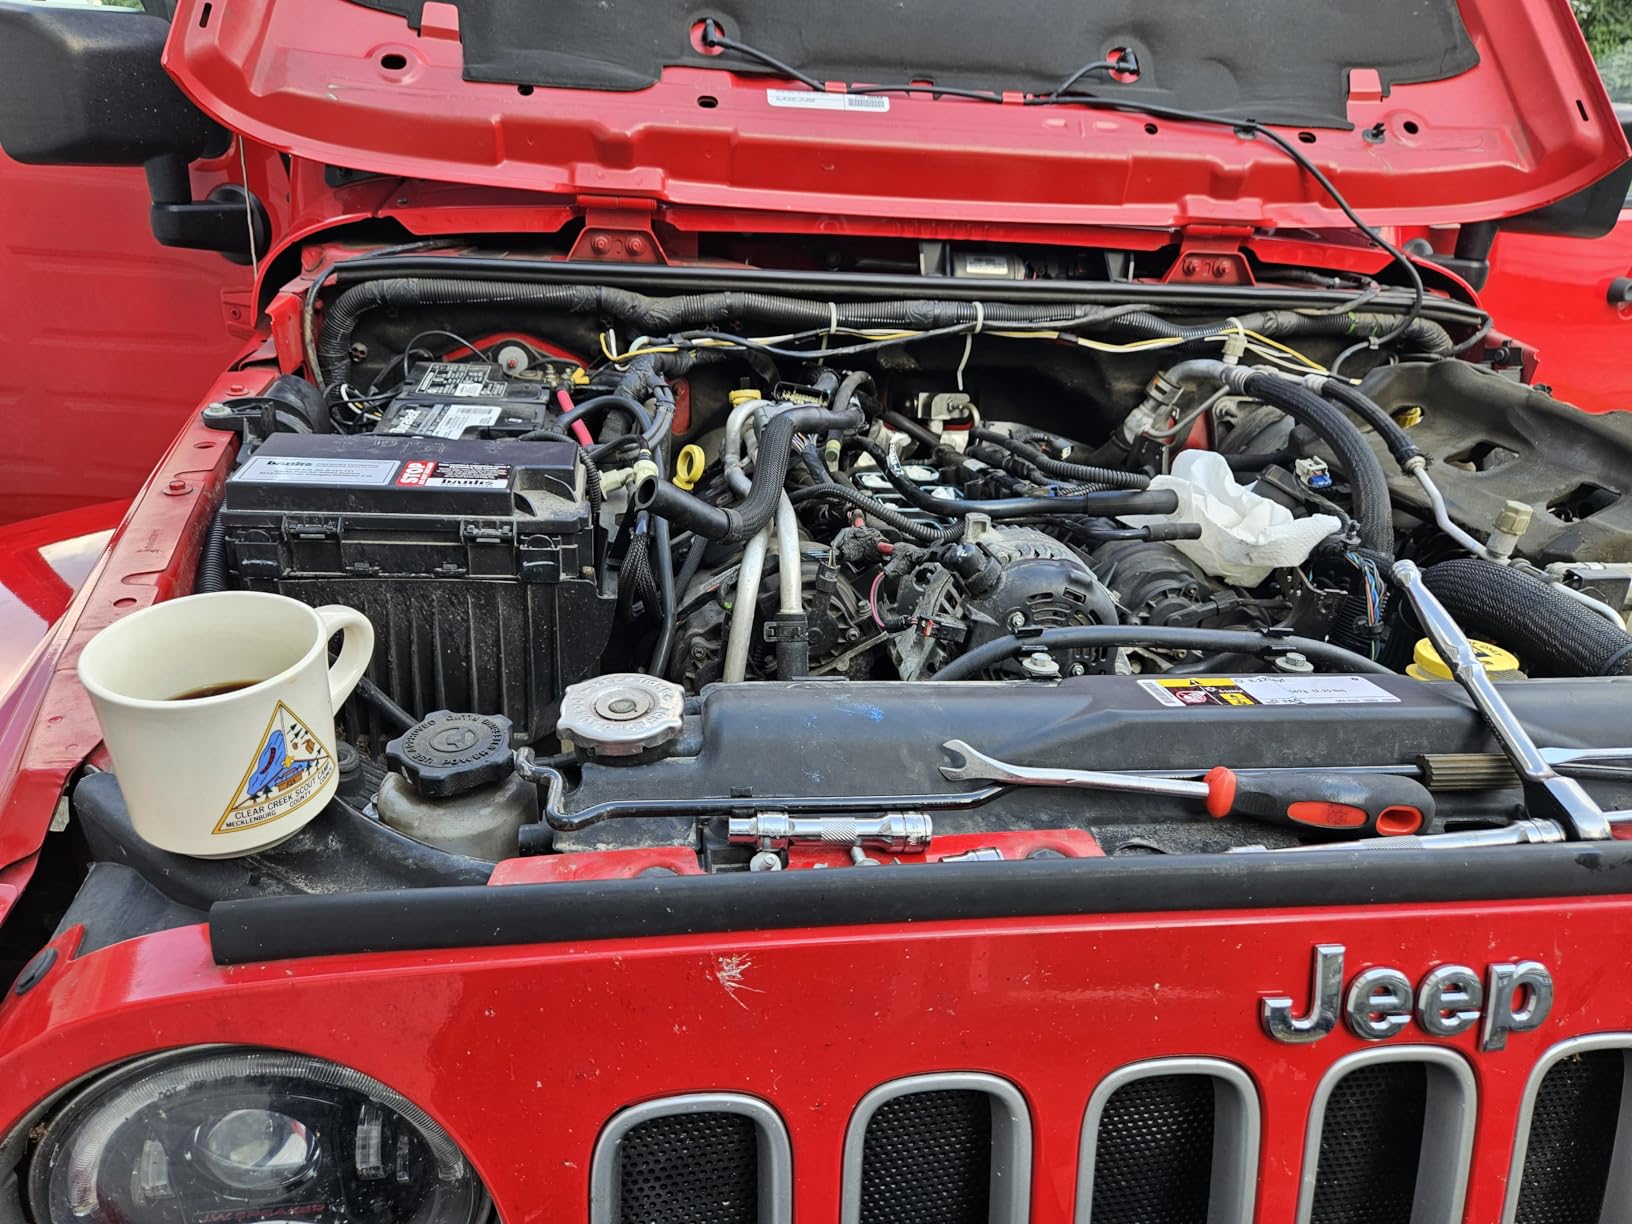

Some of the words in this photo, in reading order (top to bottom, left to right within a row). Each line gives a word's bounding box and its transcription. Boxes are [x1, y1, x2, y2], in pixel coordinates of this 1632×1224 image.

[400, 463, 425, 484] STOP
[225, 810, 277, 828] MECKLENBURG
[289, 790, 311, 807] COUNTY
[234, 806, 265, 820] CLEAR
[267, 793, 293, 811] CREEK
[295, 777, 317, 797] SCOUT
[317, 761, 330, 780] CAMP
[1260, 943, 1555, 1052] Jeep
